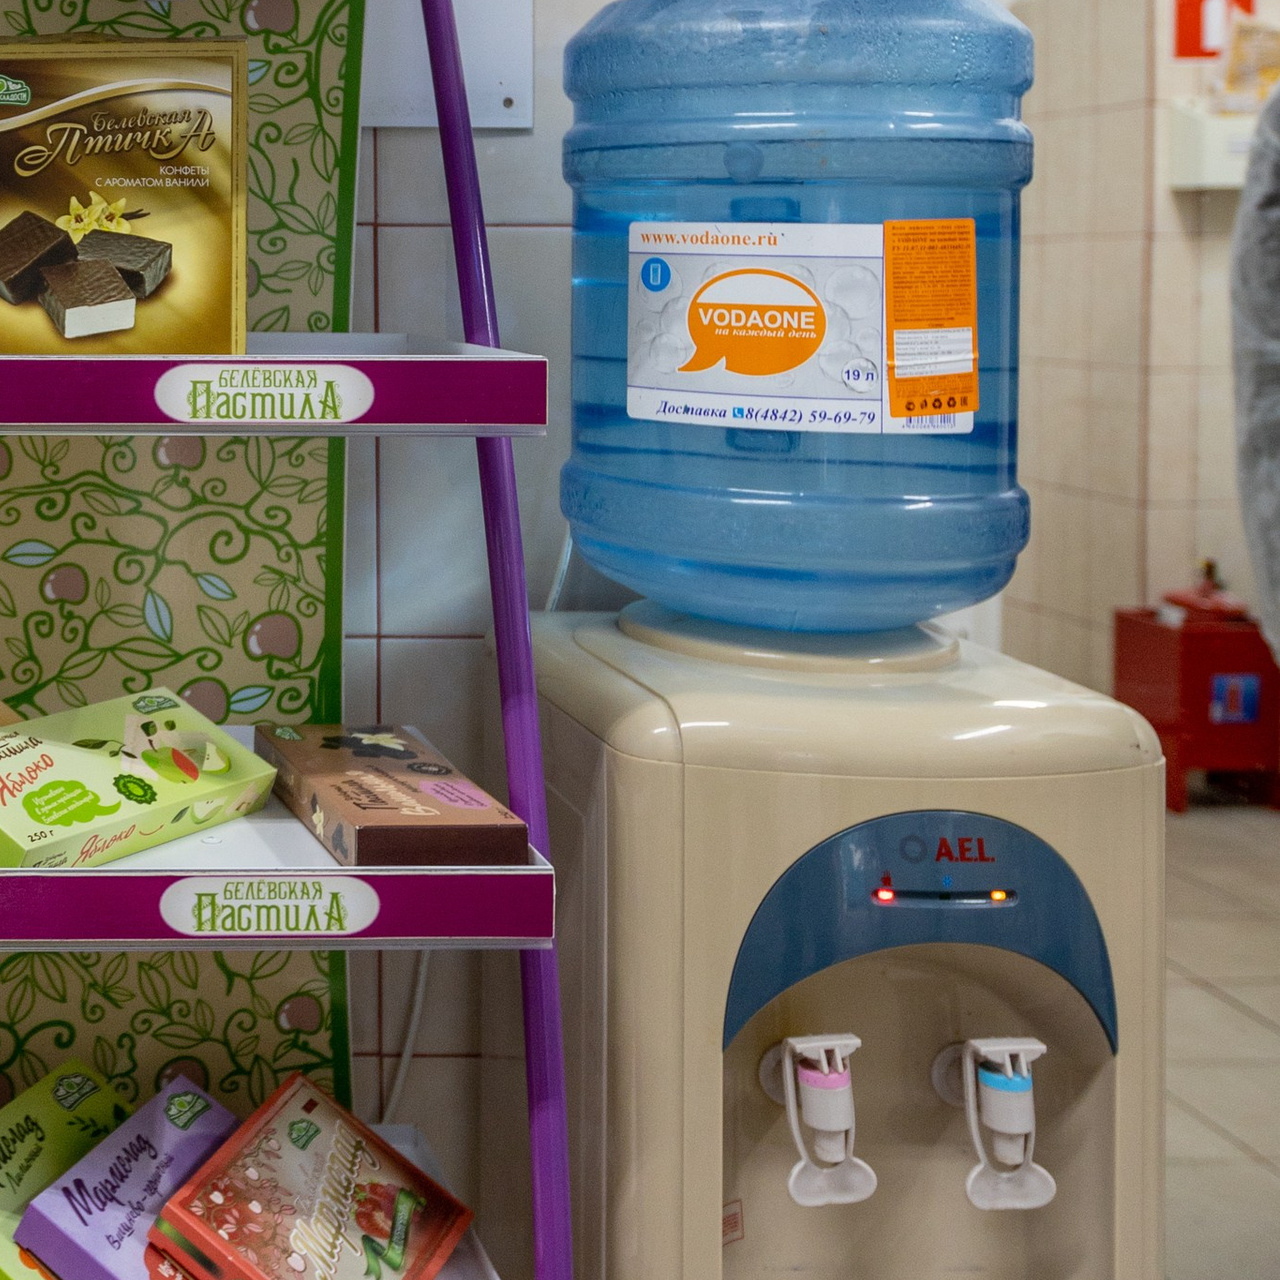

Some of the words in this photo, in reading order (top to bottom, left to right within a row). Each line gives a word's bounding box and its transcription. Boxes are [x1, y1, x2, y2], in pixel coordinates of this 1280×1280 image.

[91, 107, 192, 131] Белевская
[159, 166, 210, 176] КОНФЕТЫ
[104, 177, 164, 188] АРОМАТОМ
[165, 177, 210, 188] ВАНИЛИ
[639, 229, 778, 247] www.vodaone.ru
[698, 307, 816, 330] VODAONE
[714, 328, 730, 336] на
[731, 326, 786, 339] каждый
[788, 329, 818, 340] день
[218, 366, 318, 390] БЕЛЁВСКАЯ
[844, 368, 862, 382] 19
[864, 370, 875, 382] л
[656, 400, 728, 419] Доставка
[744, 406, 804, 423] 8(4842)
[808, 409, 877, 426] 59-69-79
[27, 830, 48, 843] 250
[223, 879, 323, 901] БЕЛЁВСКАЯ
[62, 1132, 159, 1228] Мармелад
